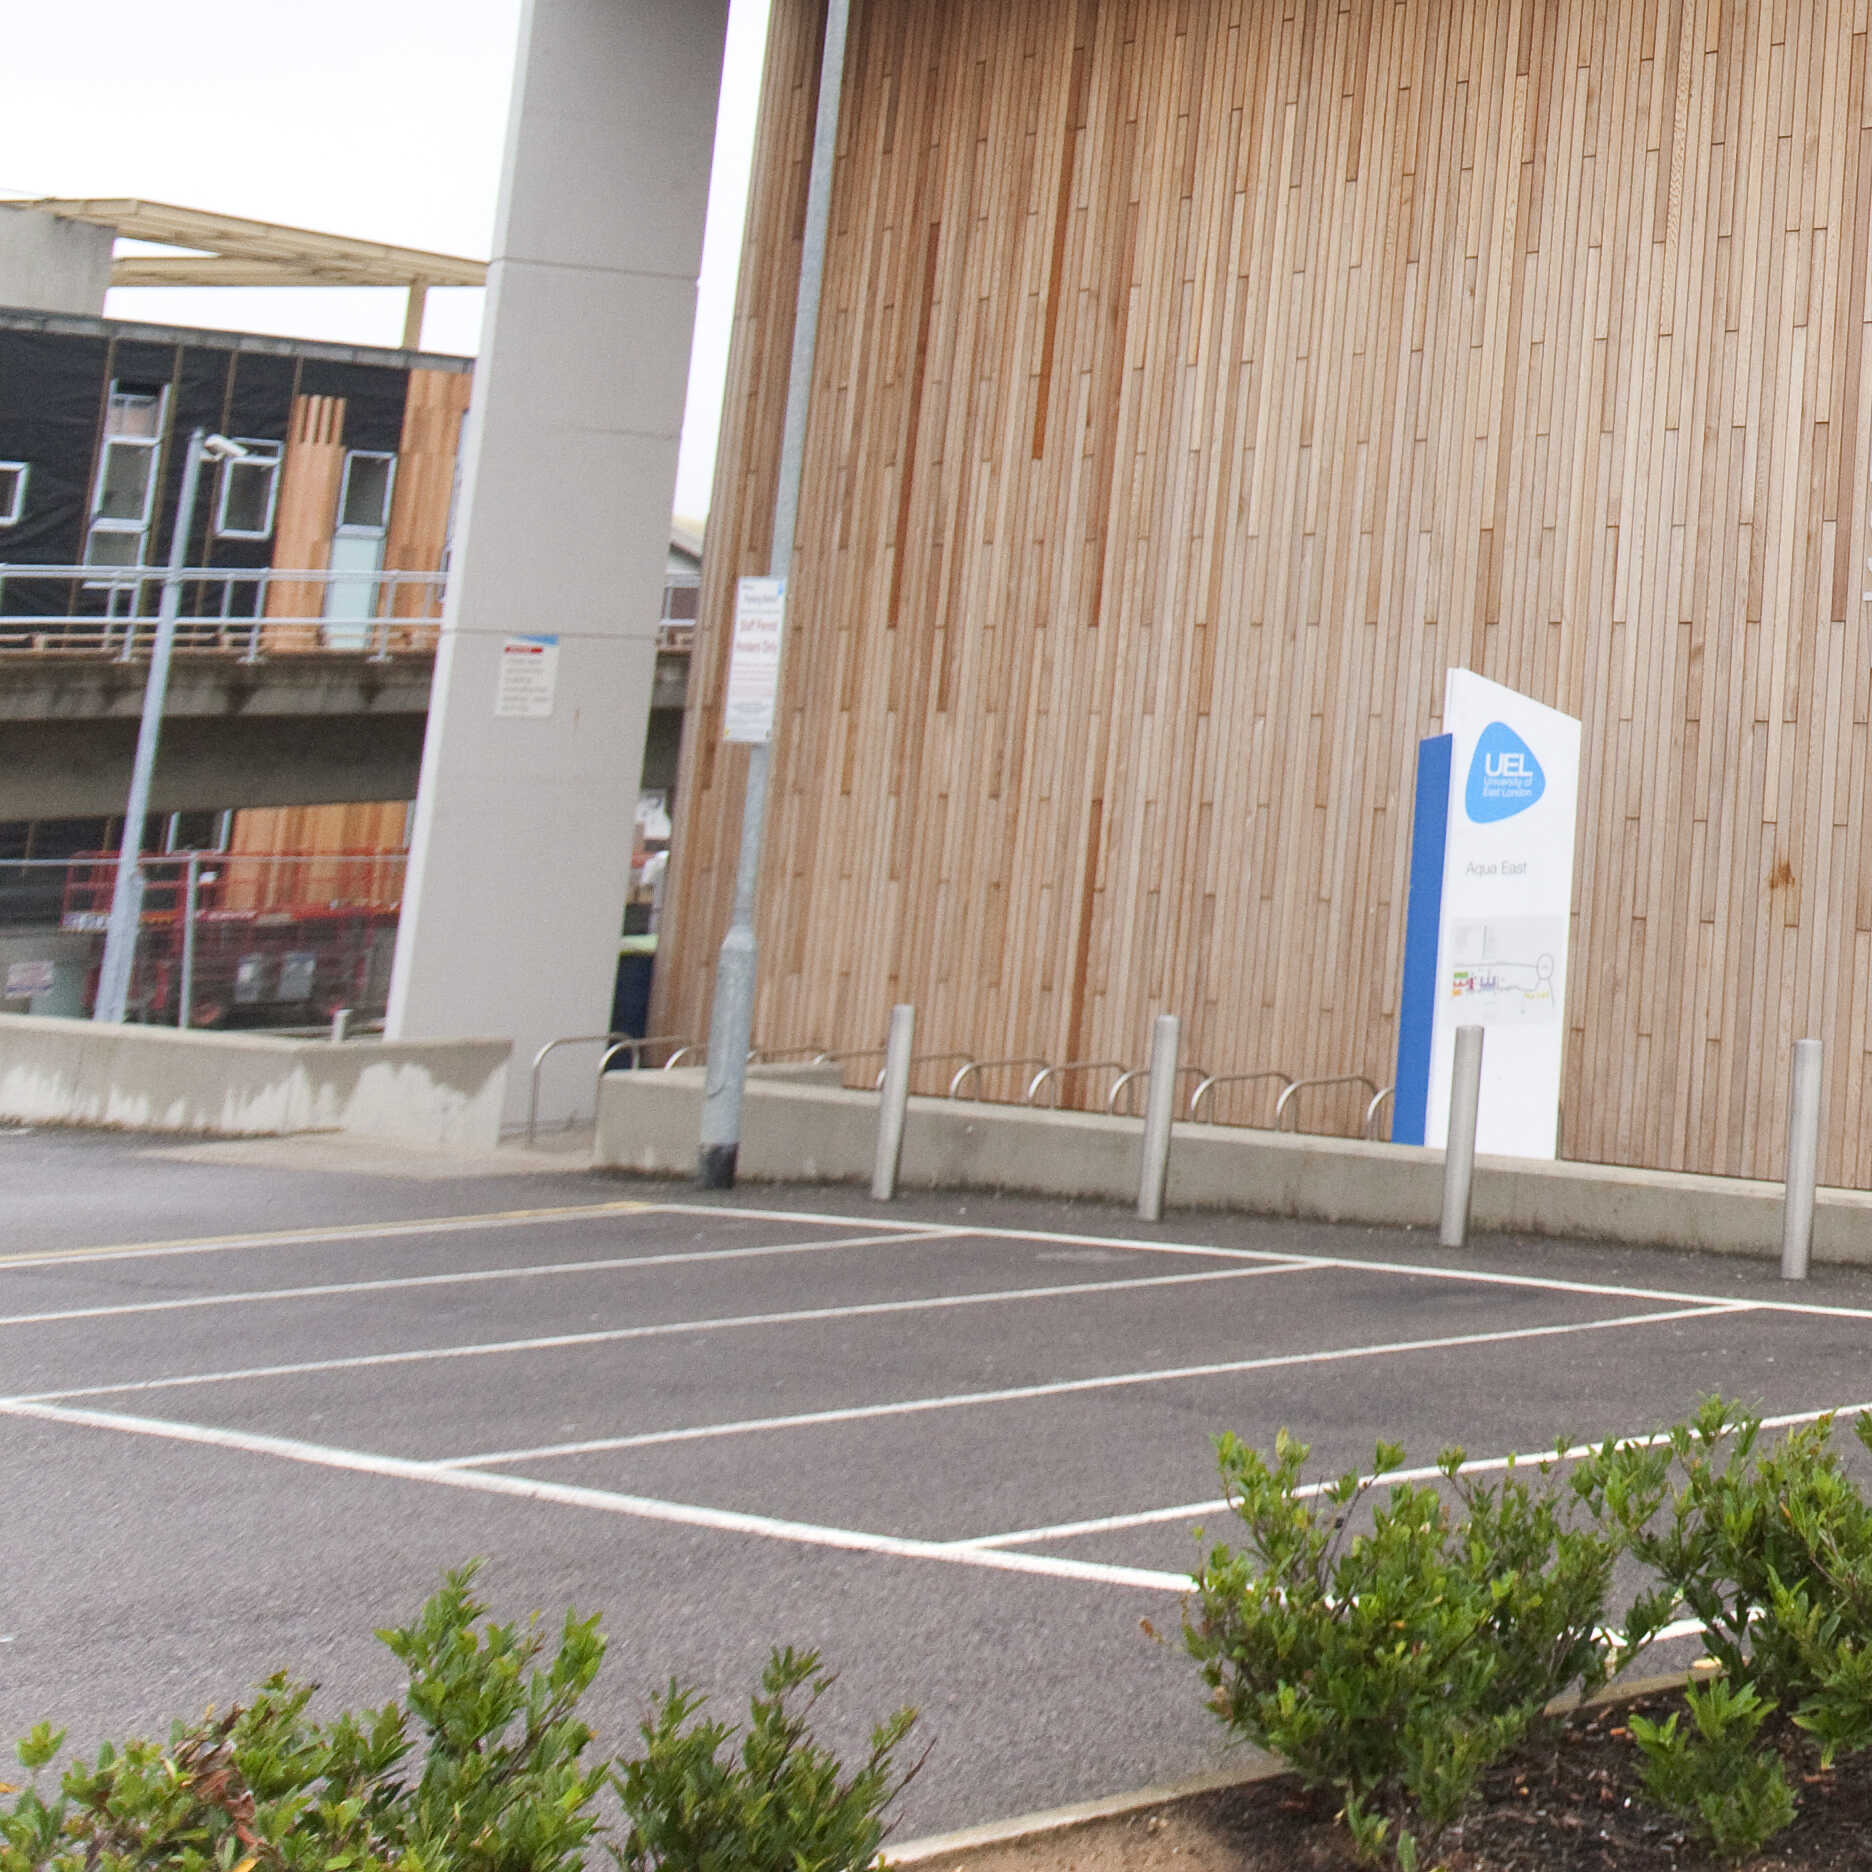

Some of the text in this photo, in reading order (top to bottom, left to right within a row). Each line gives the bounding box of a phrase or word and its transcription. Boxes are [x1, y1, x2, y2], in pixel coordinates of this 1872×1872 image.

[1485, 753, 1533, 776] UEL
[1466, 860, 1527, 877] Aqua East
